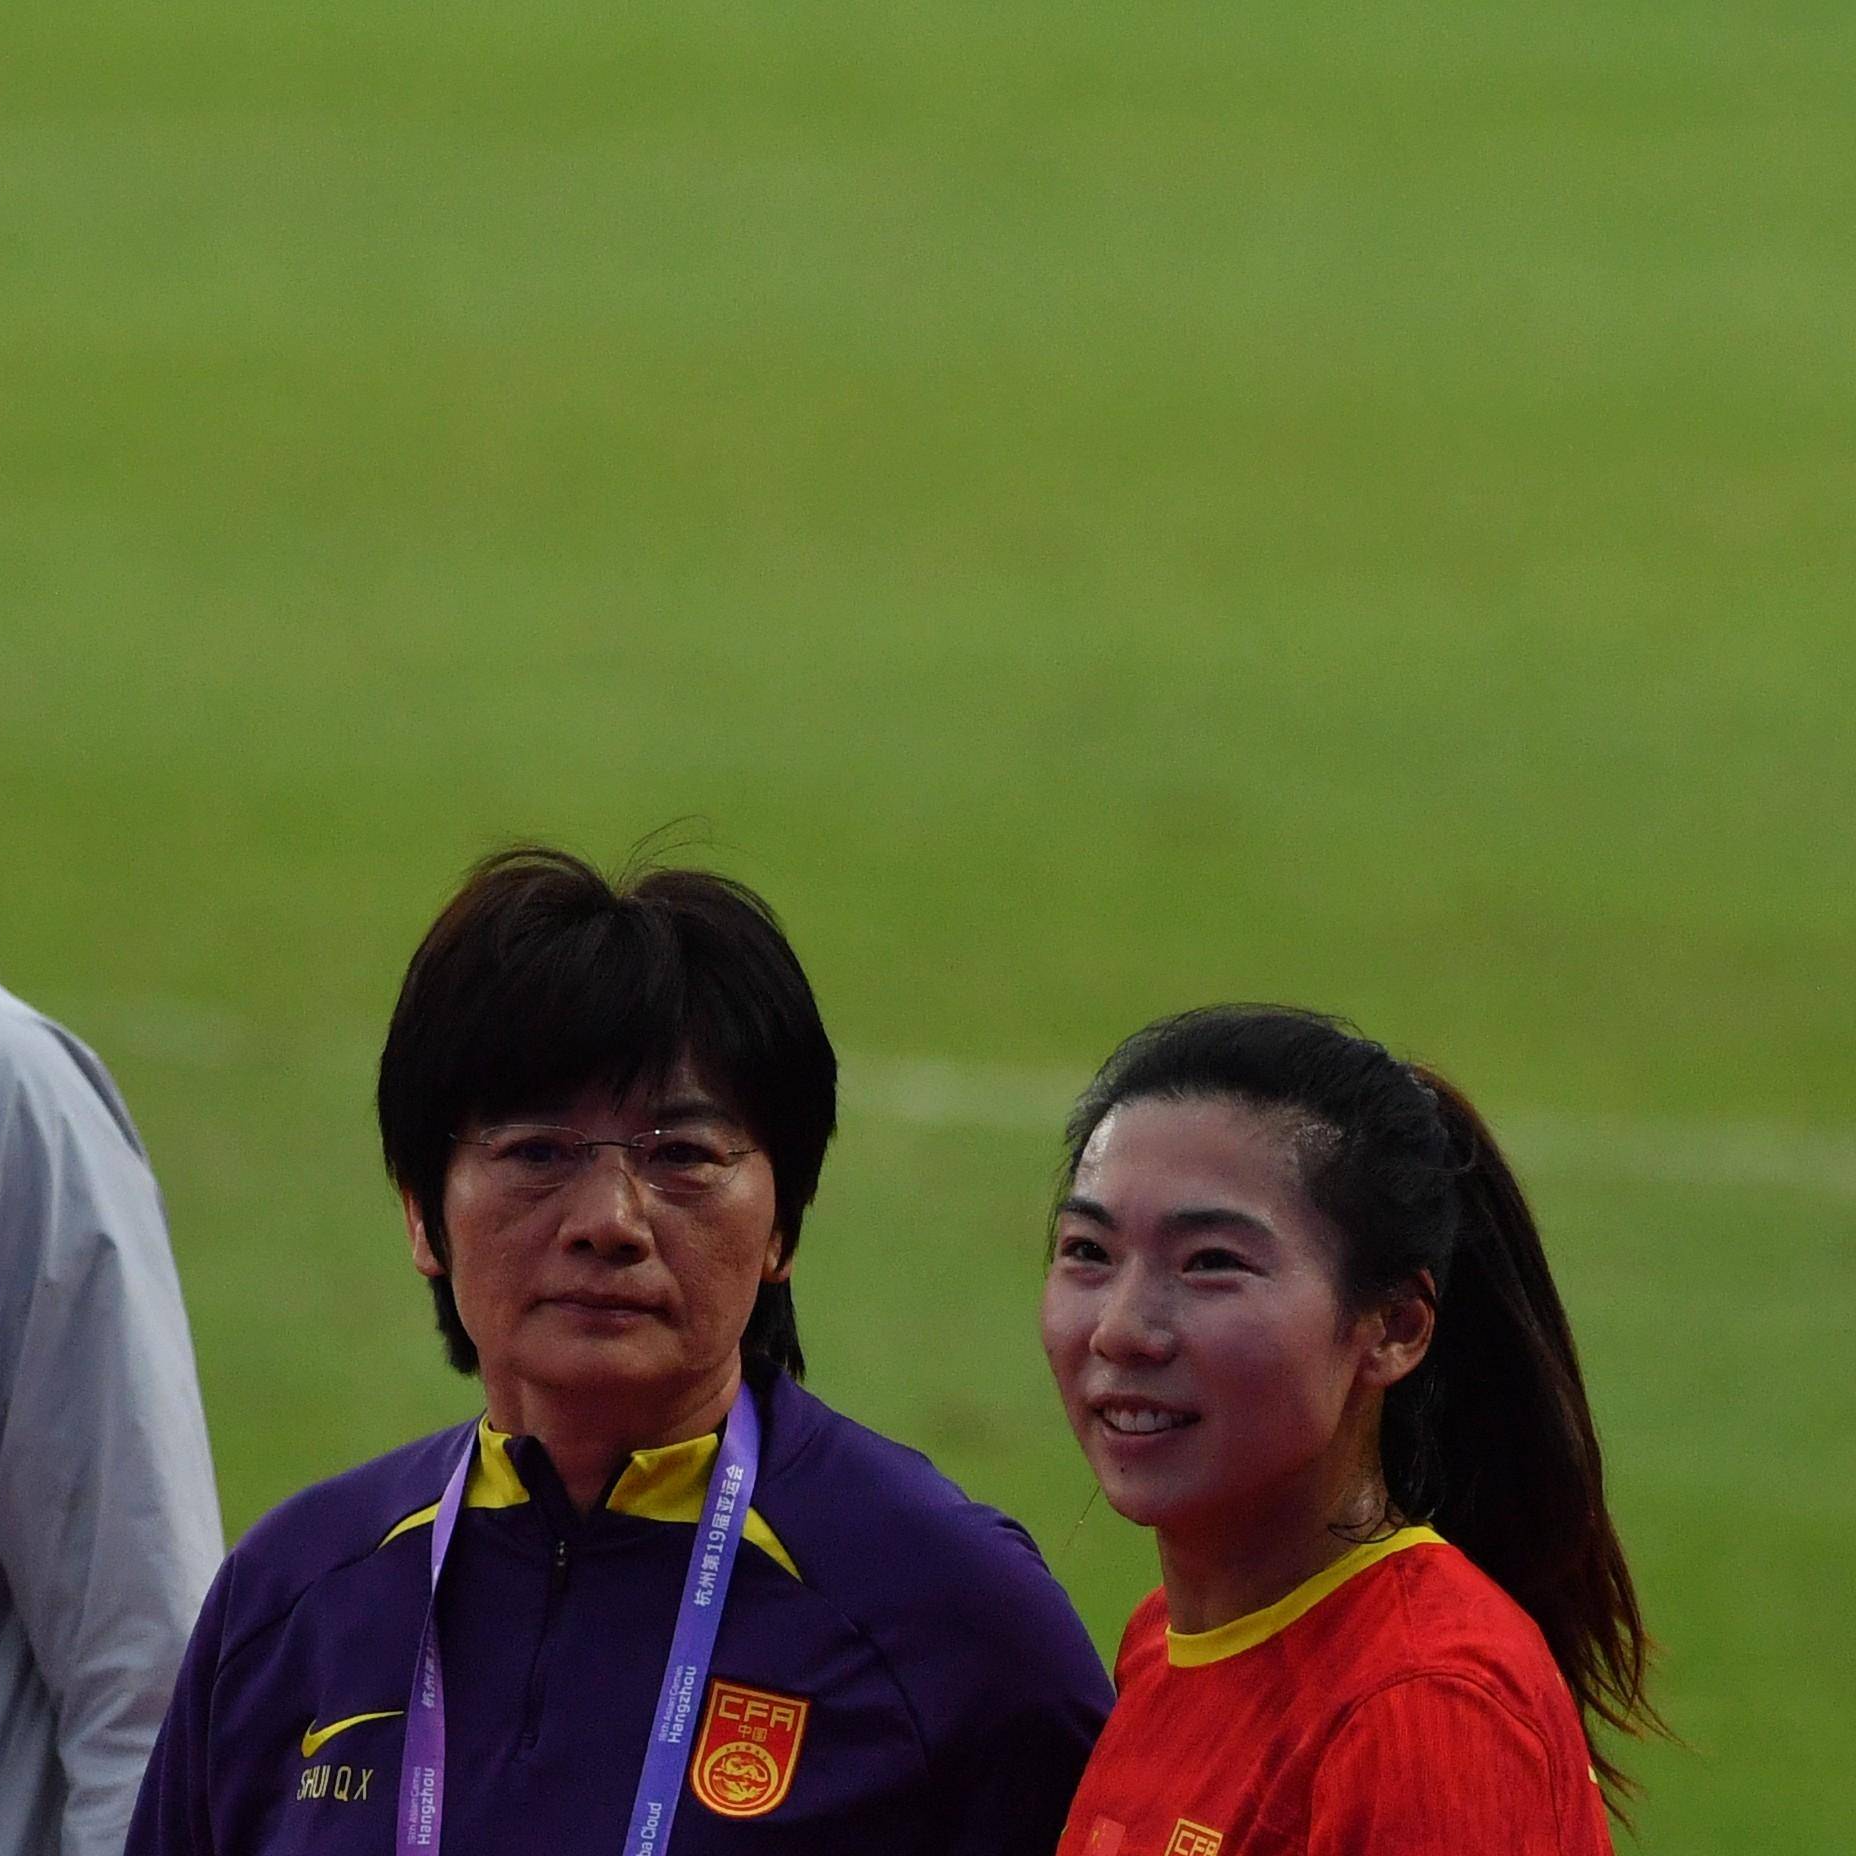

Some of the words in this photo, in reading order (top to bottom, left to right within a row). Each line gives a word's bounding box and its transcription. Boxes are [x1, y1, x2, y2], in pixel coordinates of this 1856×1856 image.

[694, 1463, 744, 1606] 杭州第19届亚运会
[667, 1665, 697, 1743] Hangzhou
[718, 1695, 795, 1731] CFA
[296, 1765, 331, 1800] SHUI
[334, 1765, 351, 1801] Q
[353, 1769, 374, 1800] X
[416, 1767, 436, 1845] Hangzhou
[640, 1802, 662, 1840] Cloud
